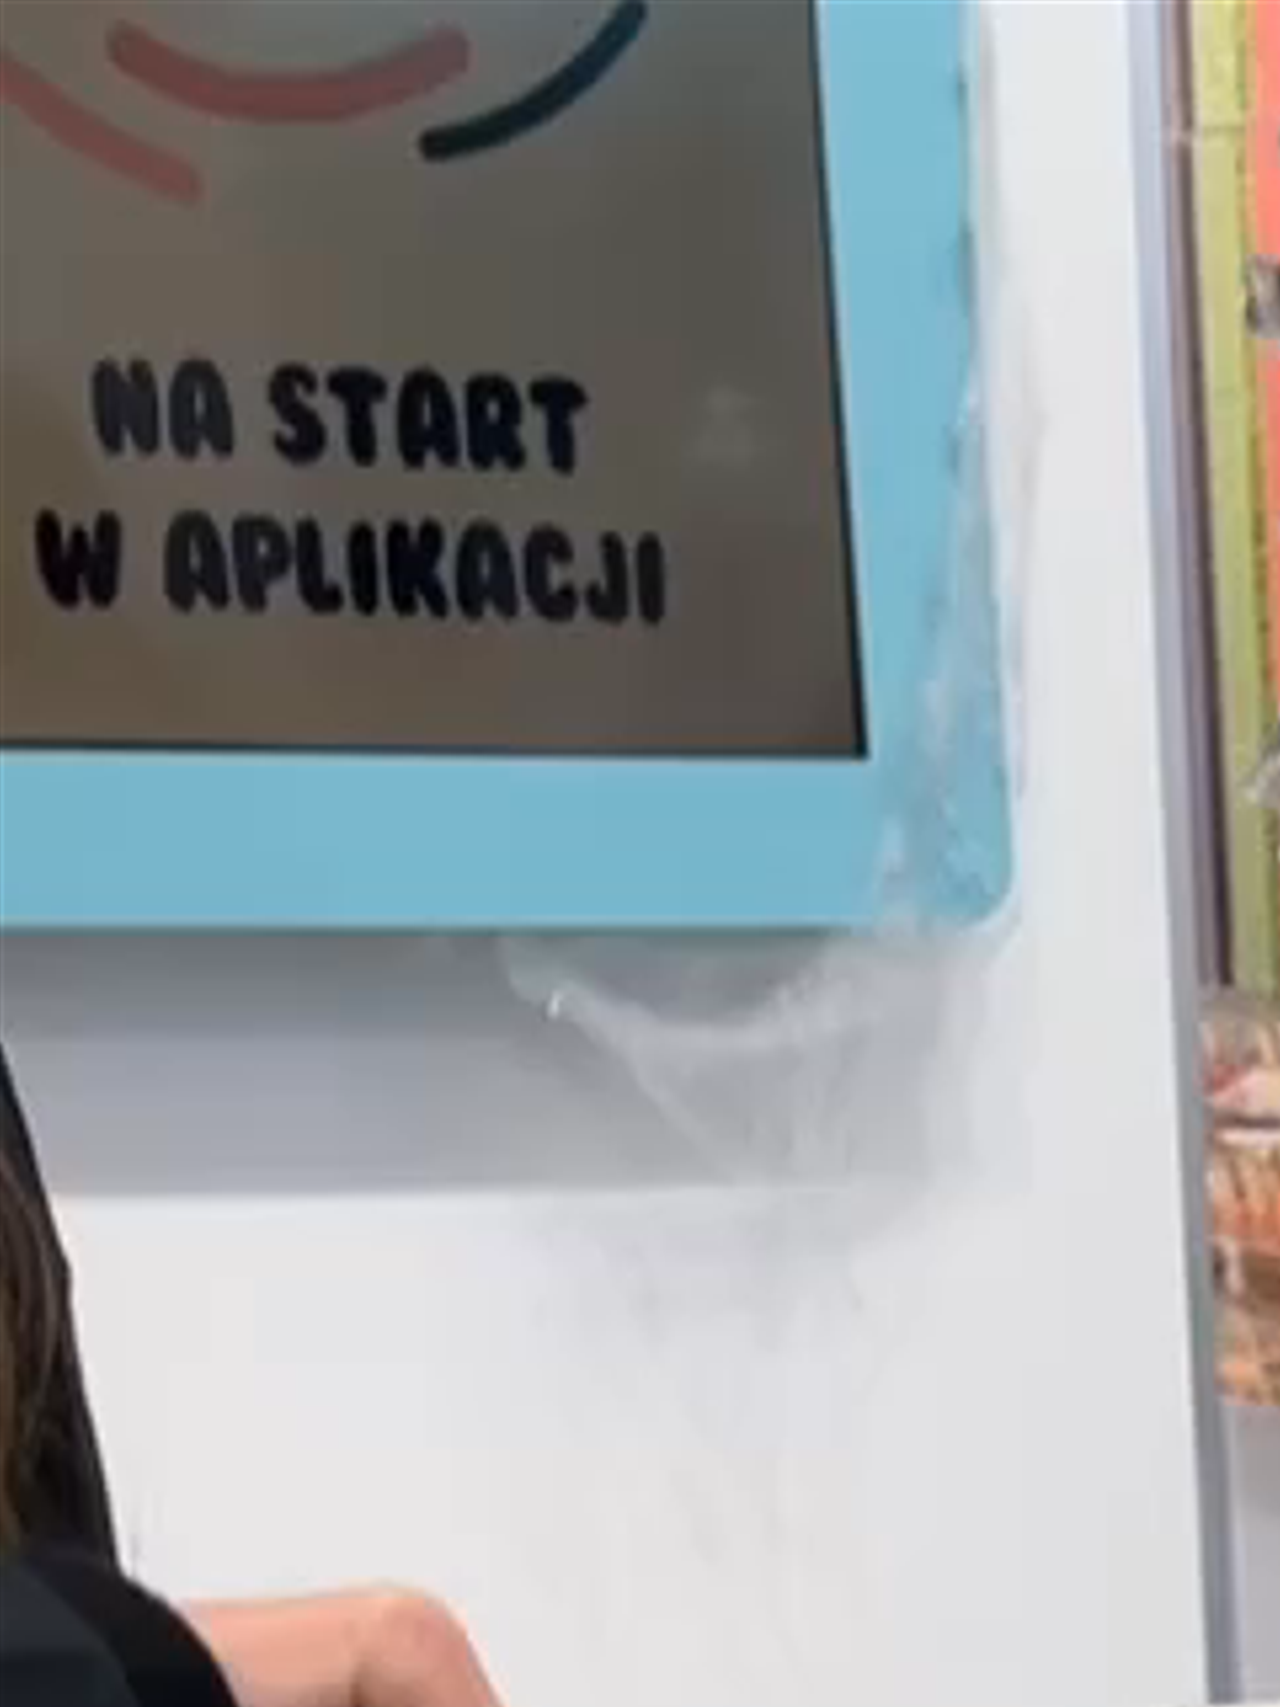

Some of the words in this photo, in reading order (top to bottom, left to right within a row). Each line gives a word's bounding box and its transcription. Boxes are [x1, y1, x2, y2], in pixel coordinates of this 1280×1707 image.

[90, 357, 236, 460] NA
[266, 362, 590, 475] START
[34, 507, 122, 611] W
[162, 508, 667, 626] APLIKACJI
